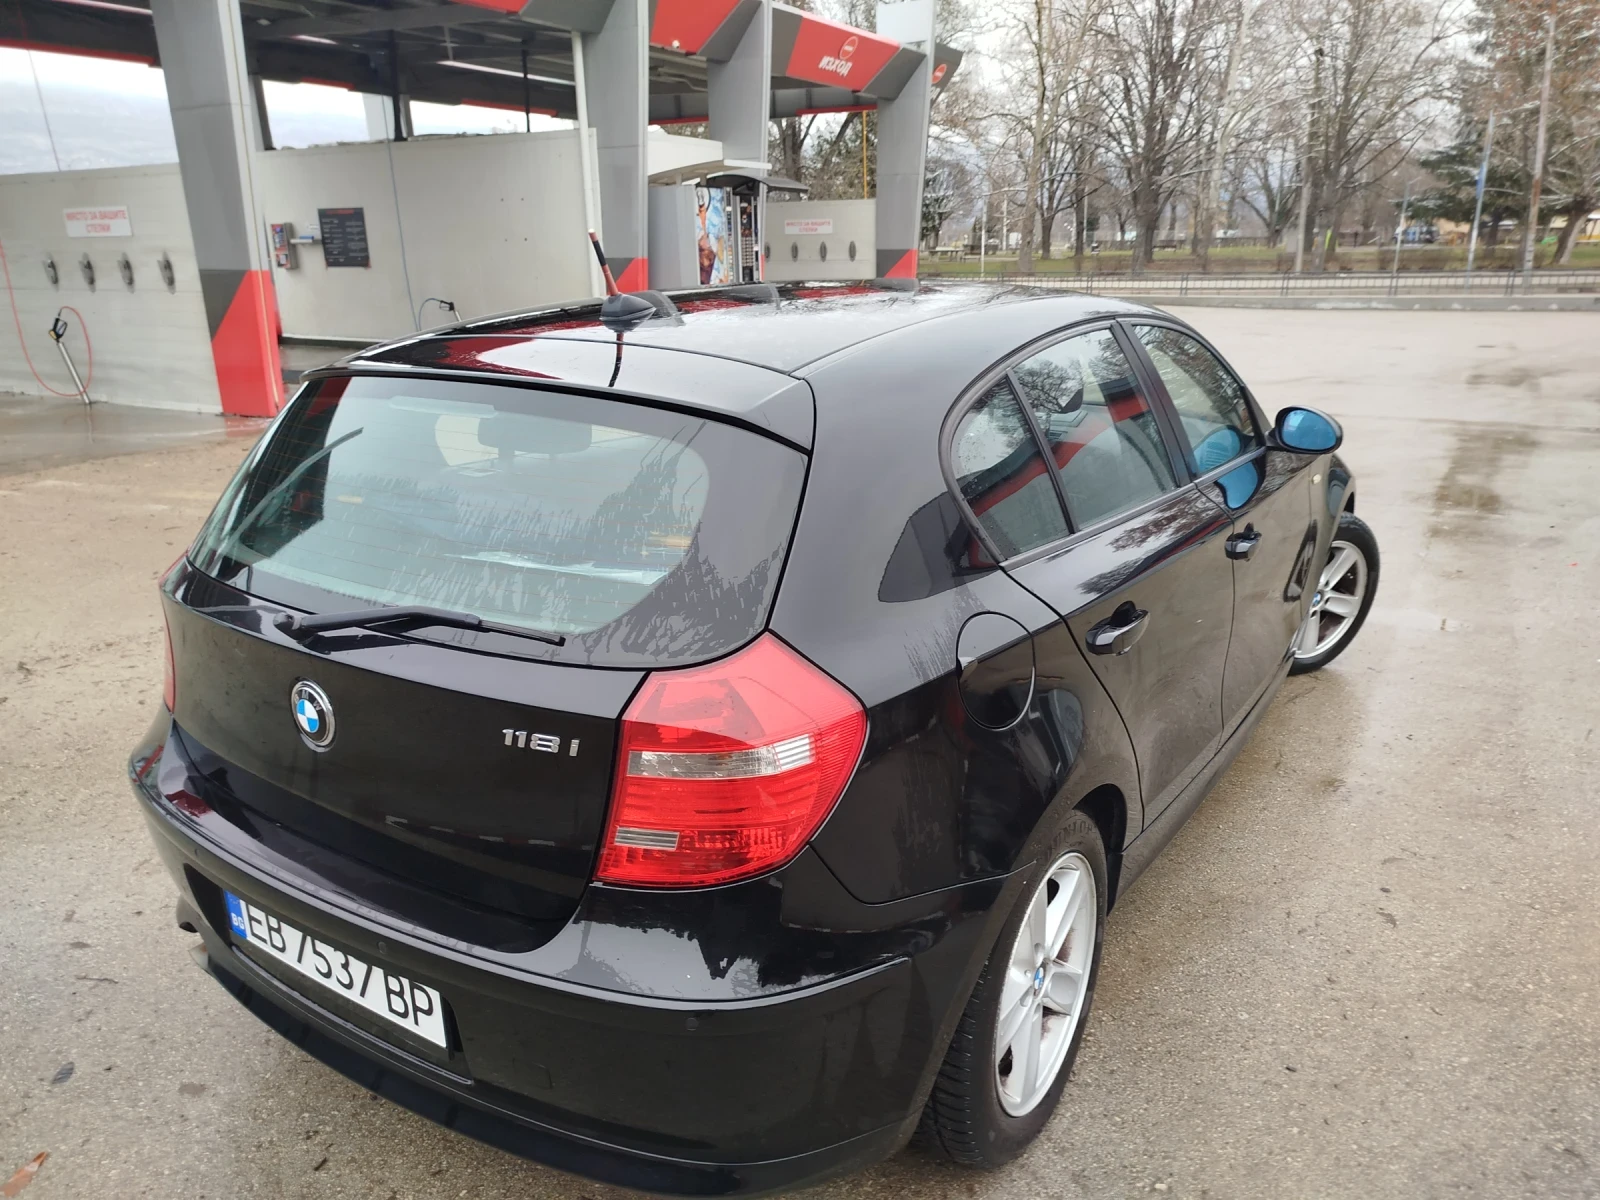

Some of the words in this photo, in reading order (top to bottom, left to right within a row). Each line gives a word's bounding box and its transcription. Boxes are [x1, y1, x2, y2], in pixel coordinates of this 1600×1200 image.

[818, 55, 853, 77] ИЗХОД
[294, 689, 323, 711] BMW
[230, 912, 245, 930] BG
[246, 902, 286, 953] EB
[383, 968, 434, 1027] BP
